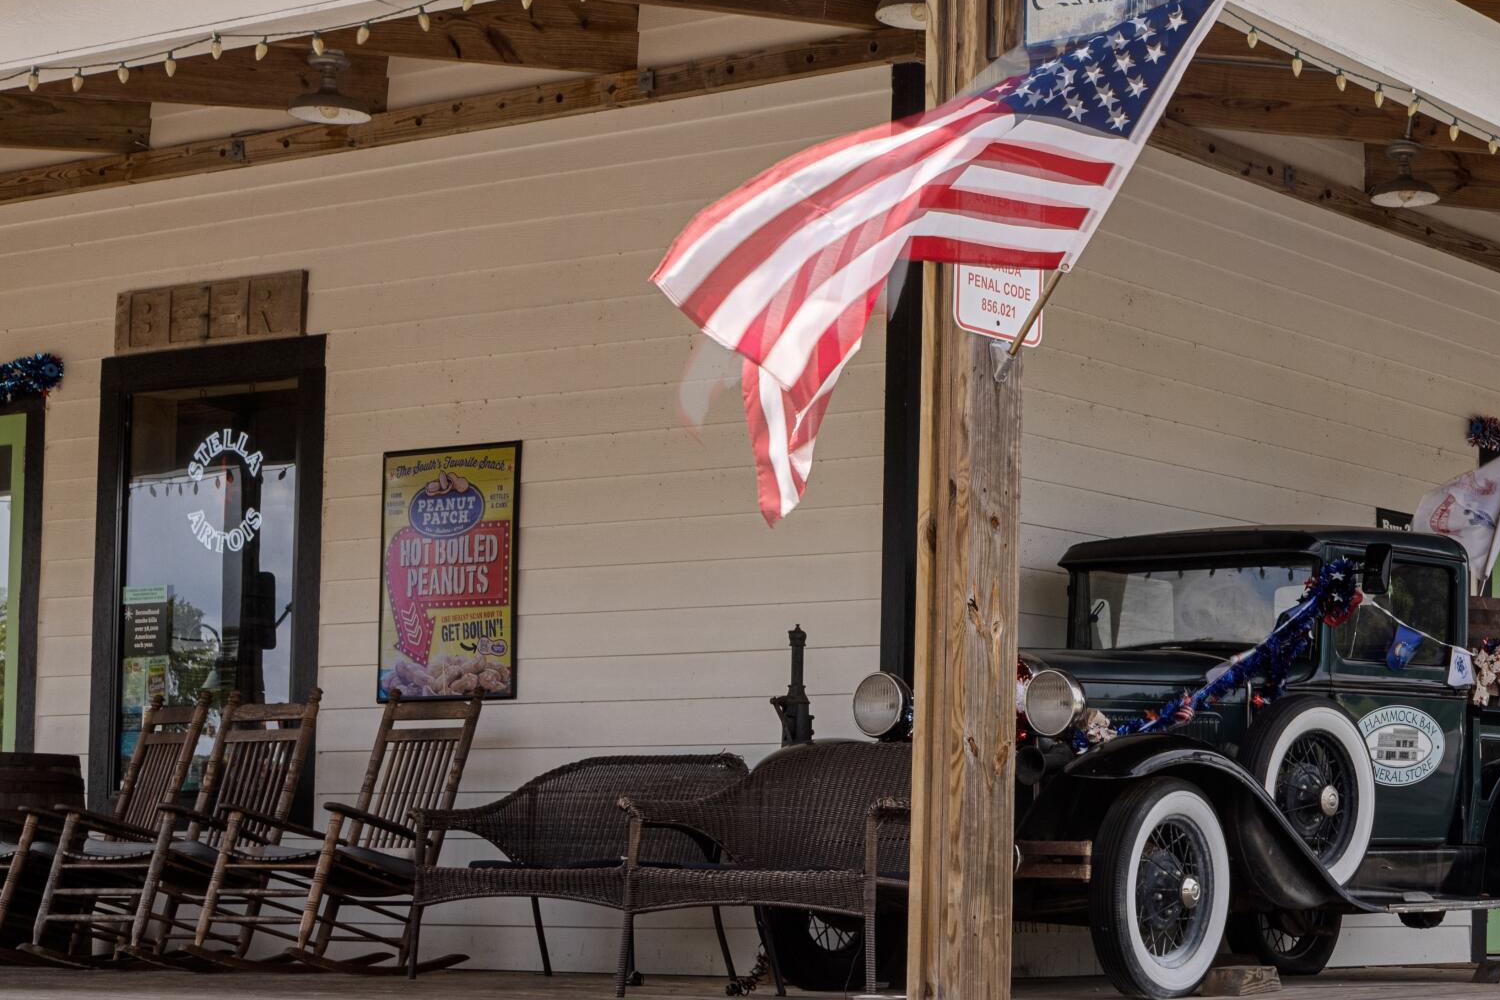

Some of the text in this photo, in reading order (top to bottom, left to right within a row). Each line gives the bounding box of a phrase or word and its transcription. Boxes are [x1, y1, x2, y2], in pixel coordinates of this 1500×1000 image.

[968, 272, 1031, 302] PENAL CODE
[129, 278, 280, 348] BEER
[188, 428, 263, 481] STELLA
[443, 455, 477, 469] Favorite
[417, 496, 476, 513] PEANUT
[422, 510, 469, 526] PATCH
[187, 507, 262, 553] ARTOIS
[400, 534, 499, 567] HOT BOILED
[407, 565, 489, 598] PEANUTS
[442, 622, 460, 642] GET
[1363, 710, 1438, 736] HAMMOCK BAY
[1405, 758, 1433, 781] STORE
